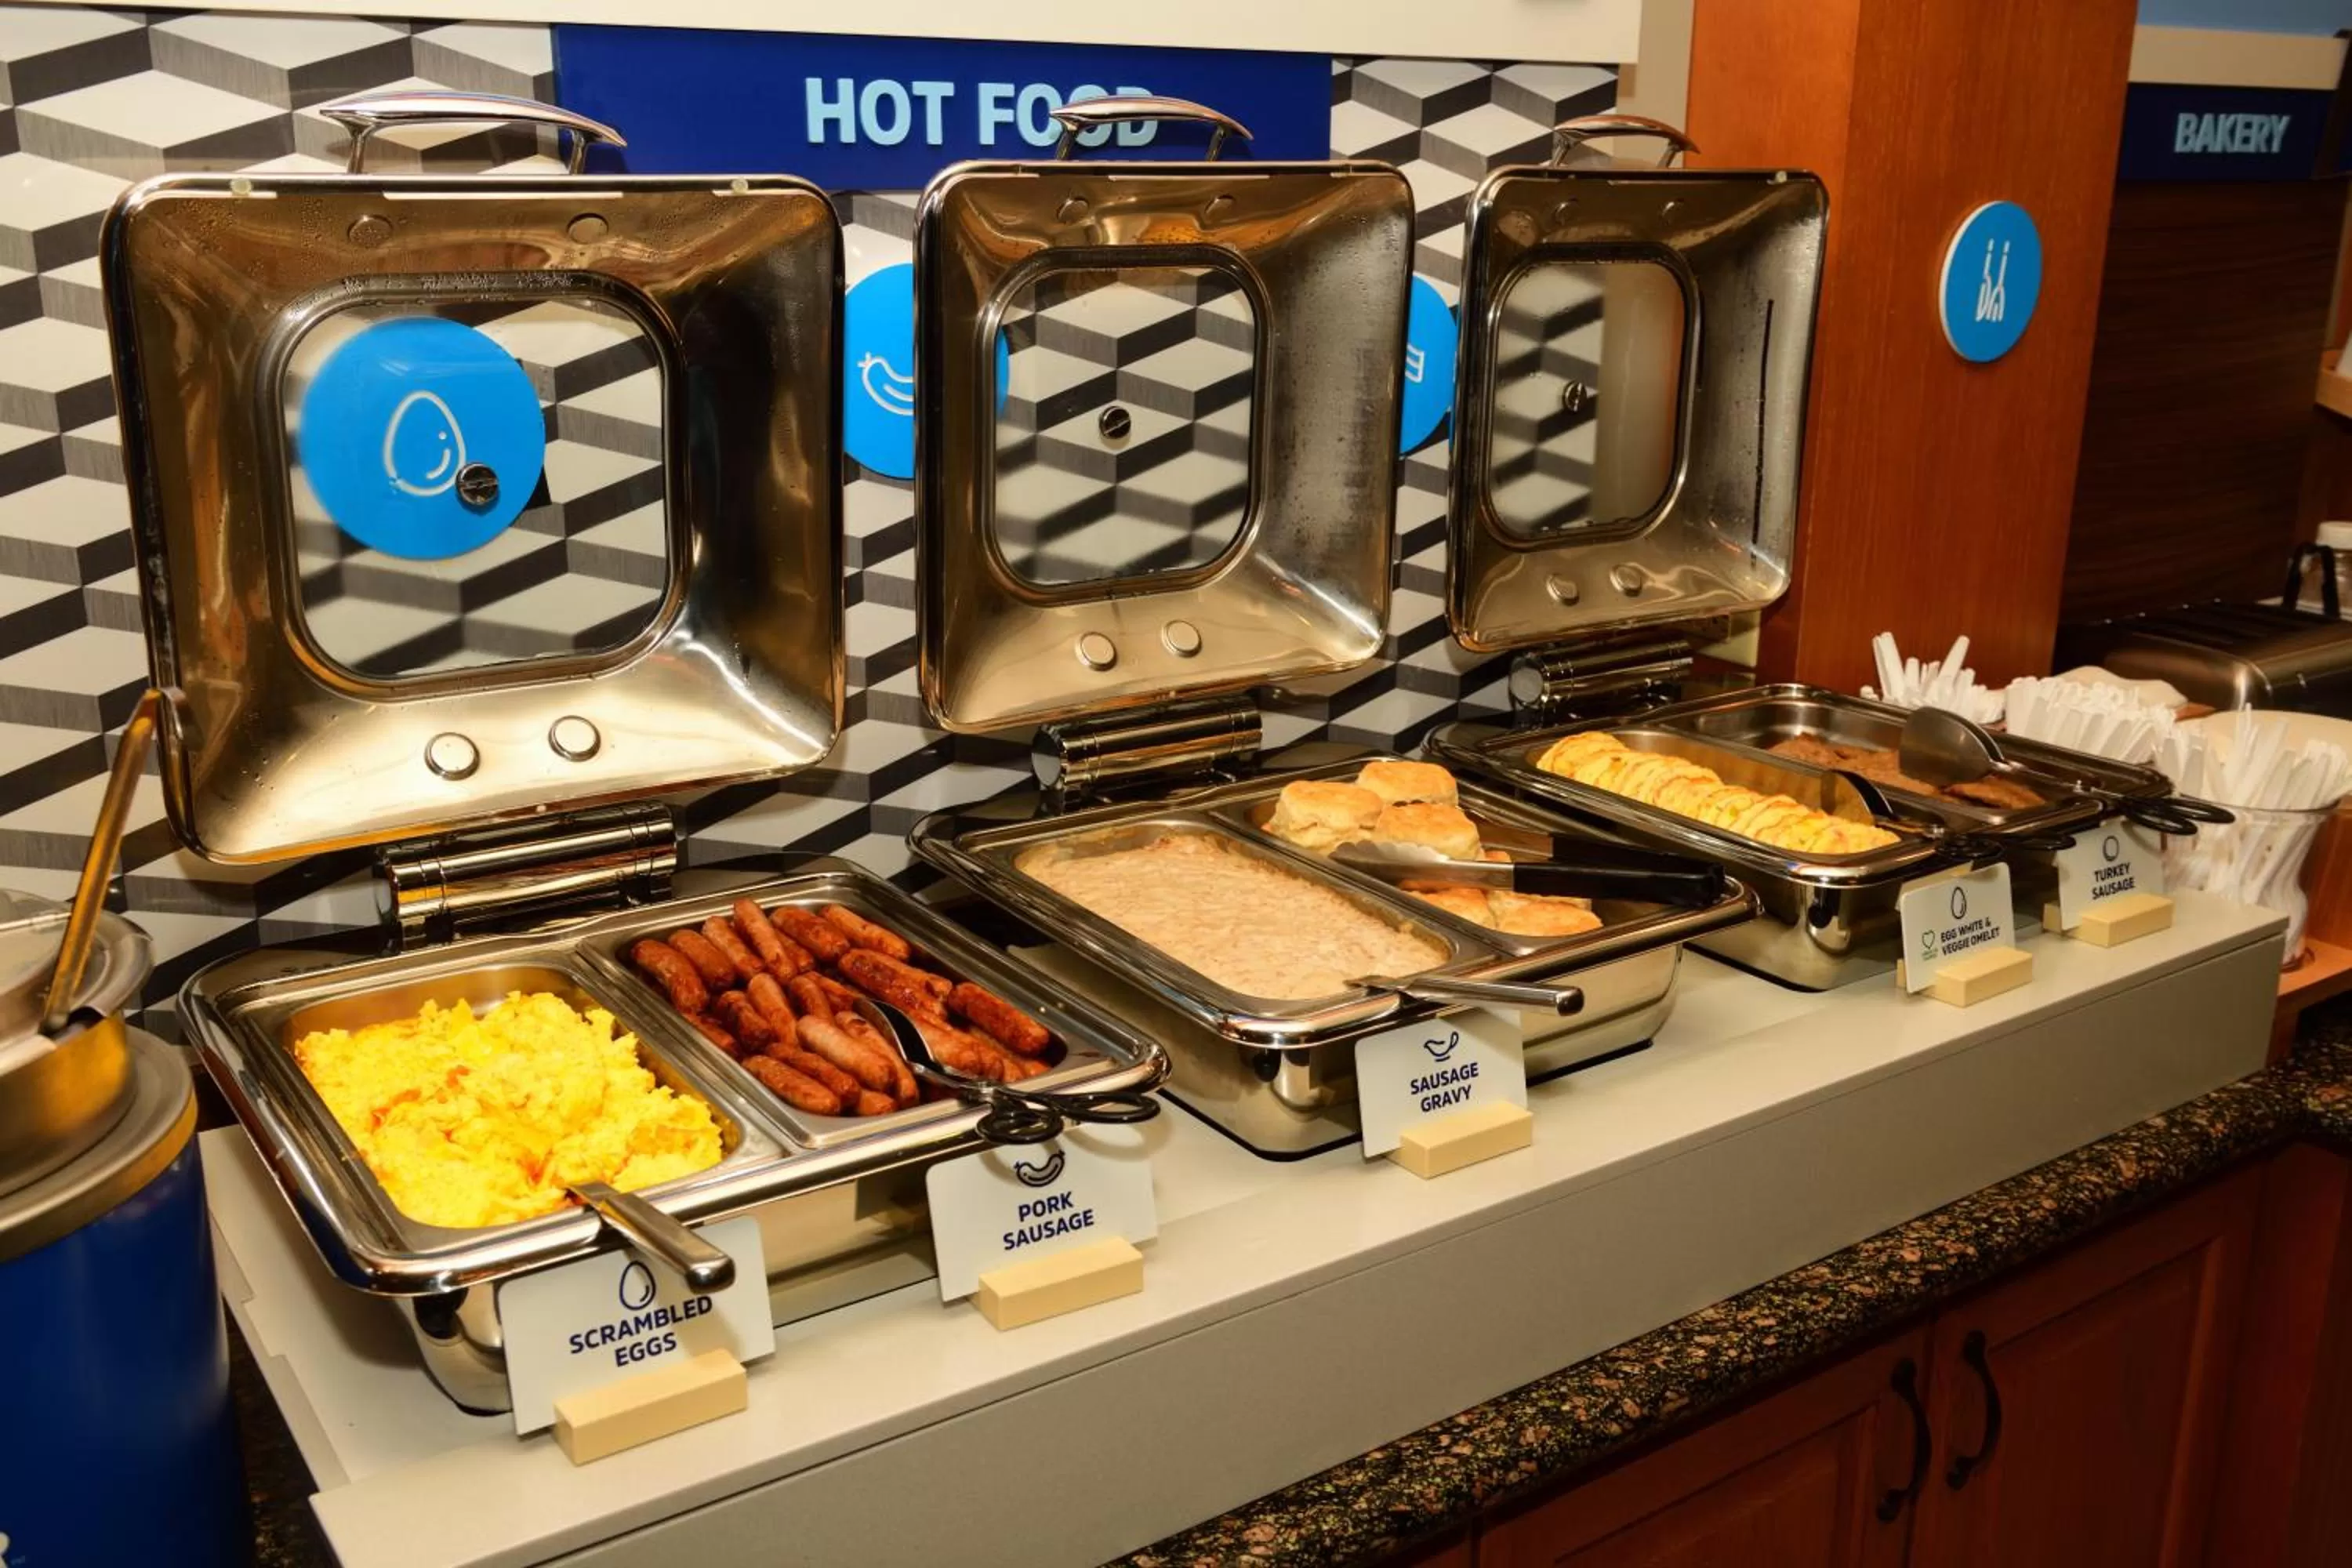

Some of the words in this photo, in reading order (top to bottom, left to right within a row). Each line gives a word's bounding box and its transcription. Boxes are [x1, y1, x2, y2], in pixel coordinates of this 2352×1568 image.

[805, 77, 954, 147] HOT
[2174, 112, 2291, 153] BAKERY
[2094, 862, 2131, 882] TURKEY
[2092, 877, 2136, 900] SAUSAGE
[1940, 928, 1957, 942] EGG
[1958, 919, 1984, 935] WHITE
[1985, 916, 1991, 927] &
[1942, 937, 1969, 956] VEGGIE
[1971, 926, 2000, 946] OMELET
[1410, 1062, 1479, 1094] SAUSAGE
[1421, 1085, 1472, 1112] GRAVY
[1018, 1191, 1074, 1221] PORK
[1003, 1209, 1094, 1250] SAUSAGE
[569, 1295, 713, 1354] SCRAMBLED
[615, 1332, 677, 1367] EGGS
